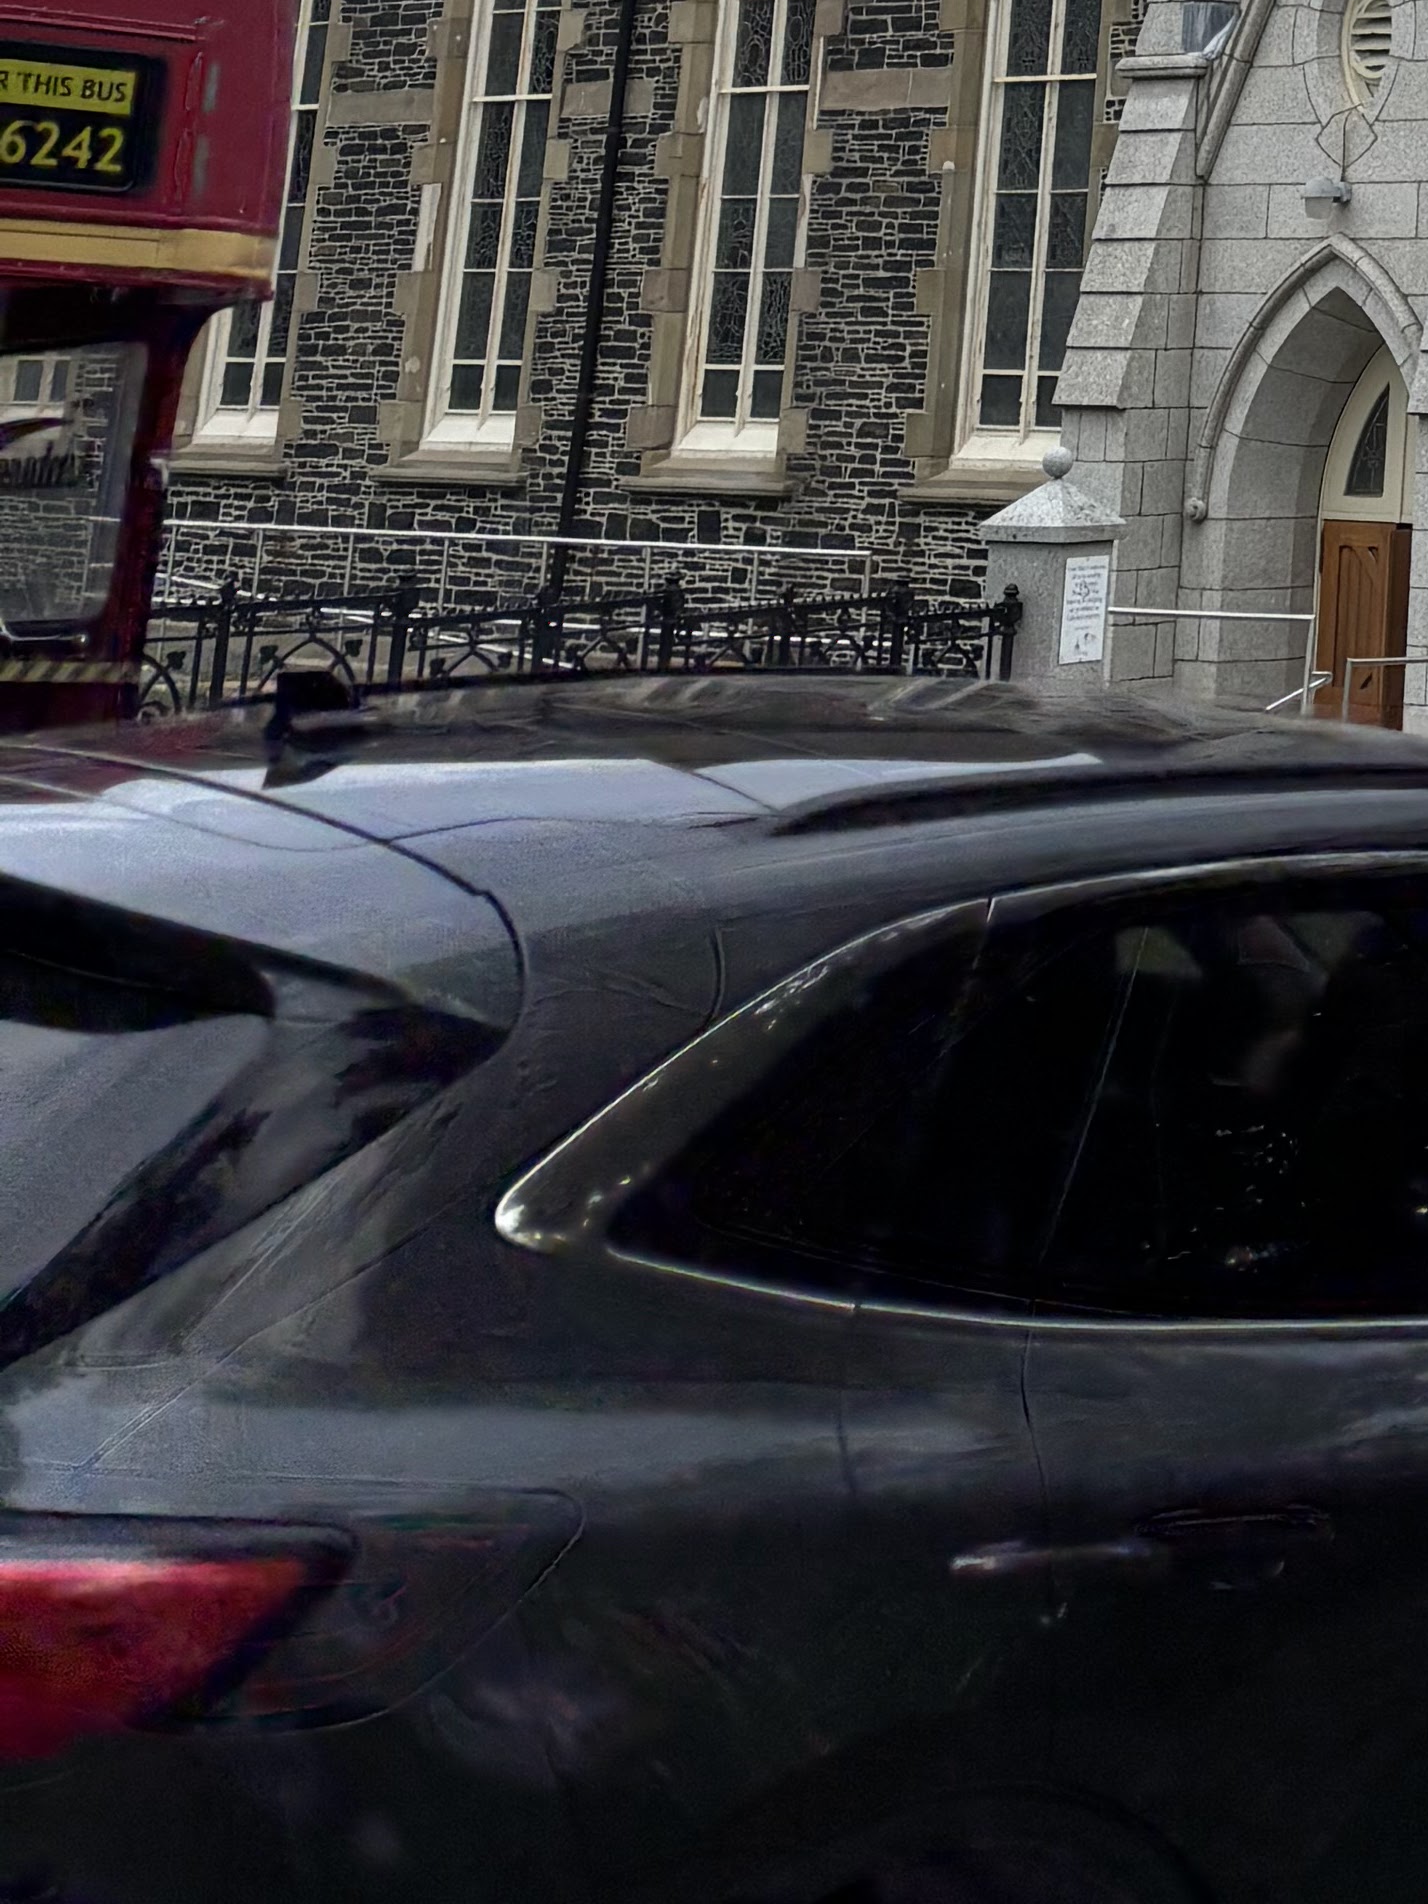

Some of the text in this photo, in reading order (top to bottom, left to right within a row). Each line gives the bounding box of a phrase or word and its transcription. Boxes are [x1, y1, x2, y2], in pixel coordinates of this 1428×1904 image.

[17, 72, 74, 97] THIS
[81, 79, 128, 102] BUS
[0, 119, 125, 173] 6242
